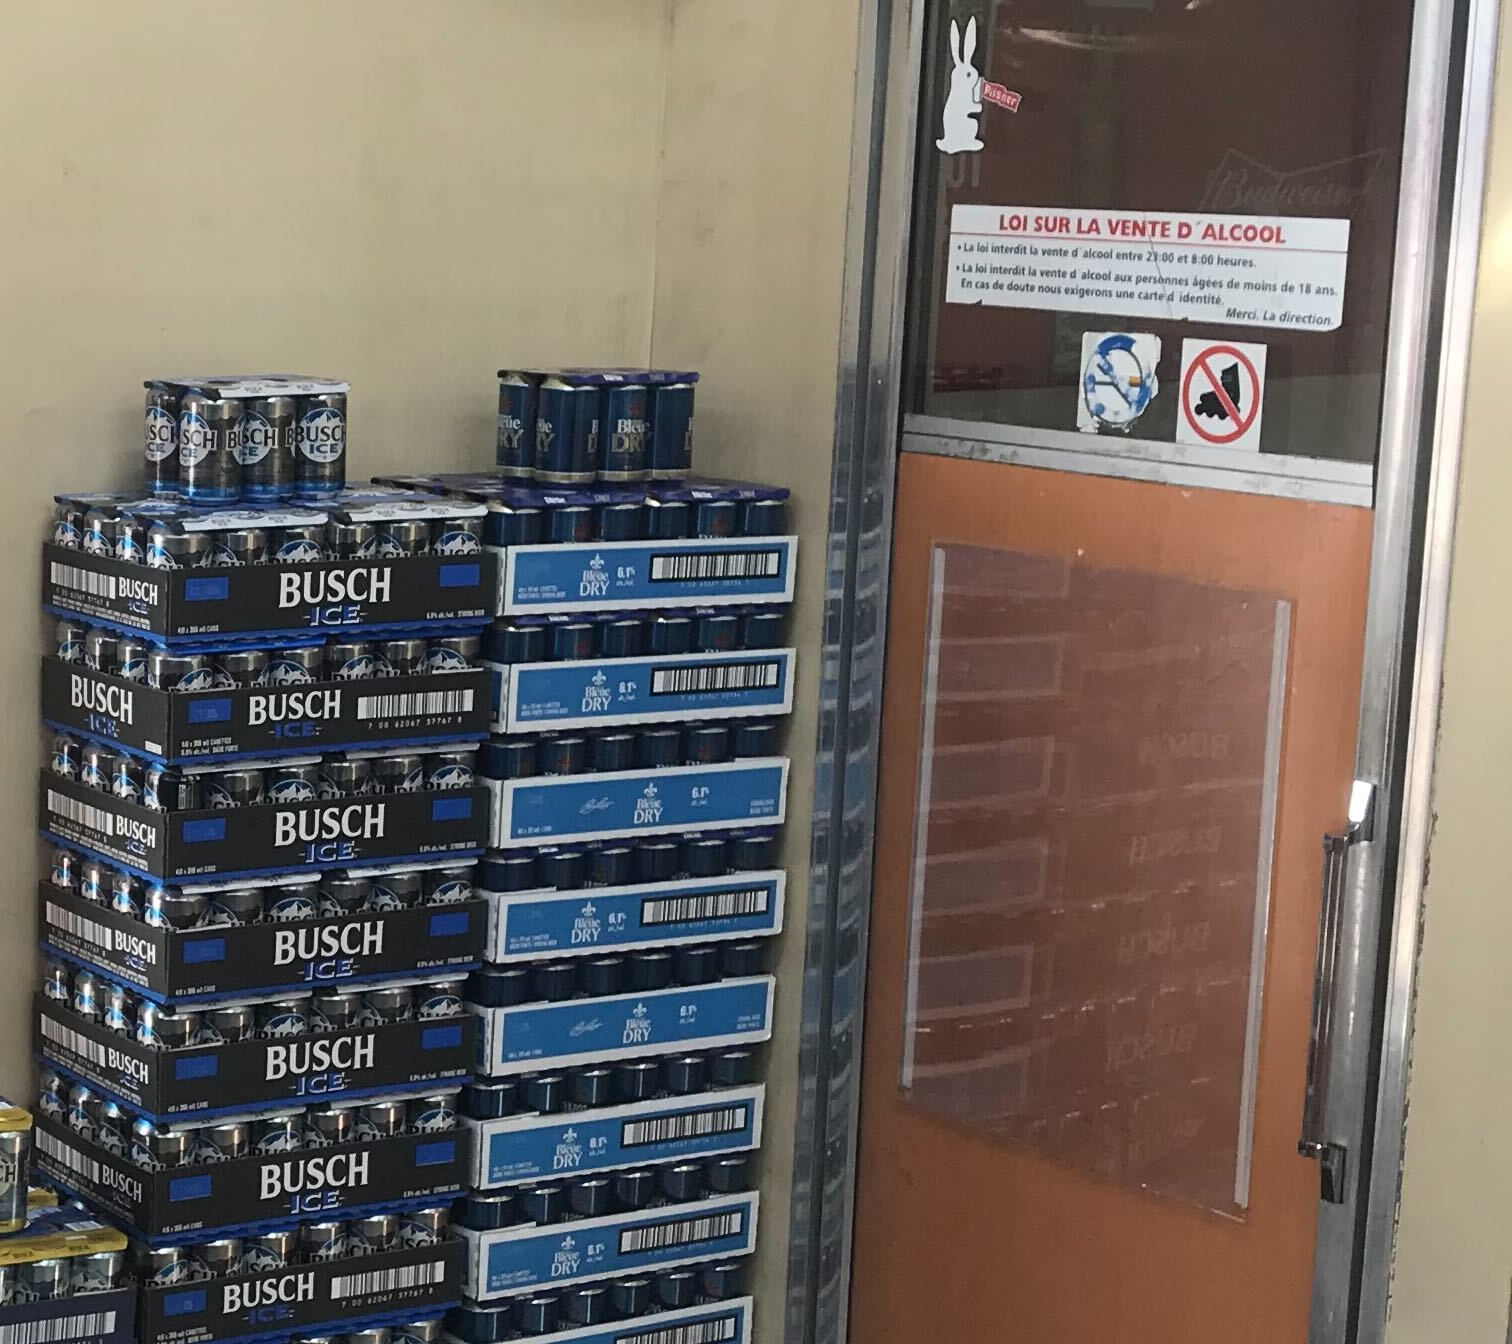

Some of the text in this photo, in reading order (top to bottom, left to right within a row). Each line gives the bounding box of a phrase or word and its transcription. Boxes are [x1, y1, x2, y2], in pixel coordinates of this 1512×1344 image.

[984, 84, 1017, 107] Pilsner
[999, 214, 1028, 232] LOI
[1034, 215, 1071, 234] SUR
[1077, 217, 1101, 235] LA
[1107, 218, 1171, 238] VENTE
[964, 242, 974, 253] La
[977, 243, 988, 253] loi
[991, 244, 1027, 256] interdit
[1030, 245, 1038, 256] la
[1041, 247, 1069, 258] vente
[1116, 250, 1143, 261] entre
[1177, 253, 1188, 264] et
[1191, 253, 1214, 265] 8:00
[1217, 254, 1257, 268] heures.
[961, 278, 973, 289] En
[975, 280, 990, 290] cas
[992, 279, 1005, 291] de
[1006, 281, 1035, 293] doute
[1038, 283, 1062, 295] nous
[1064, 284, 1113, 299] exigerons
[1116, 289, 1135, 300] une
[1138, 290, 1163, 302] carte
[962, 263, 973, 274] La
[975, 263, 987, 274] loi
[989, 264, 1026, 276] interdit
[1028, 265, 1037, 277] la
[1040, 268, 1067, 279] vente
[1114, 273, 1132, 283] aux
[1135, 273, 1189, 287] personnes
[1226, 278, 1241, 290] de
[1243, 280, 1277, 293] moins
[1280, 281, 1295, 293] de
[1299, 283, 1311, 294] 18
[1315, 285, 1338, 297] ans.
[1226, 307, 1334, 327] Merci. La direction.
[309, 443, 338, 454] ICE
[118, 577, 158, 606] BUSCH
[278, 567, 392, 608] BUSCH
[579, 580, 610, 597] DRY
[310, 605, 363, 626] ICE
[70, 674, 134, 725] BUSCH
[247, 689, 342, 727] BUSCH
[274, 803, 386, 847] BUSCH
[633, 808, 663, 824] DRY
[274, 920, 384, 966] BUSCH
[265, 1034, 376, 1081] BUSCH
[259, 1151, 371, 1201] BUSCH
[222, 1272, 317, 1315] BUSCH
